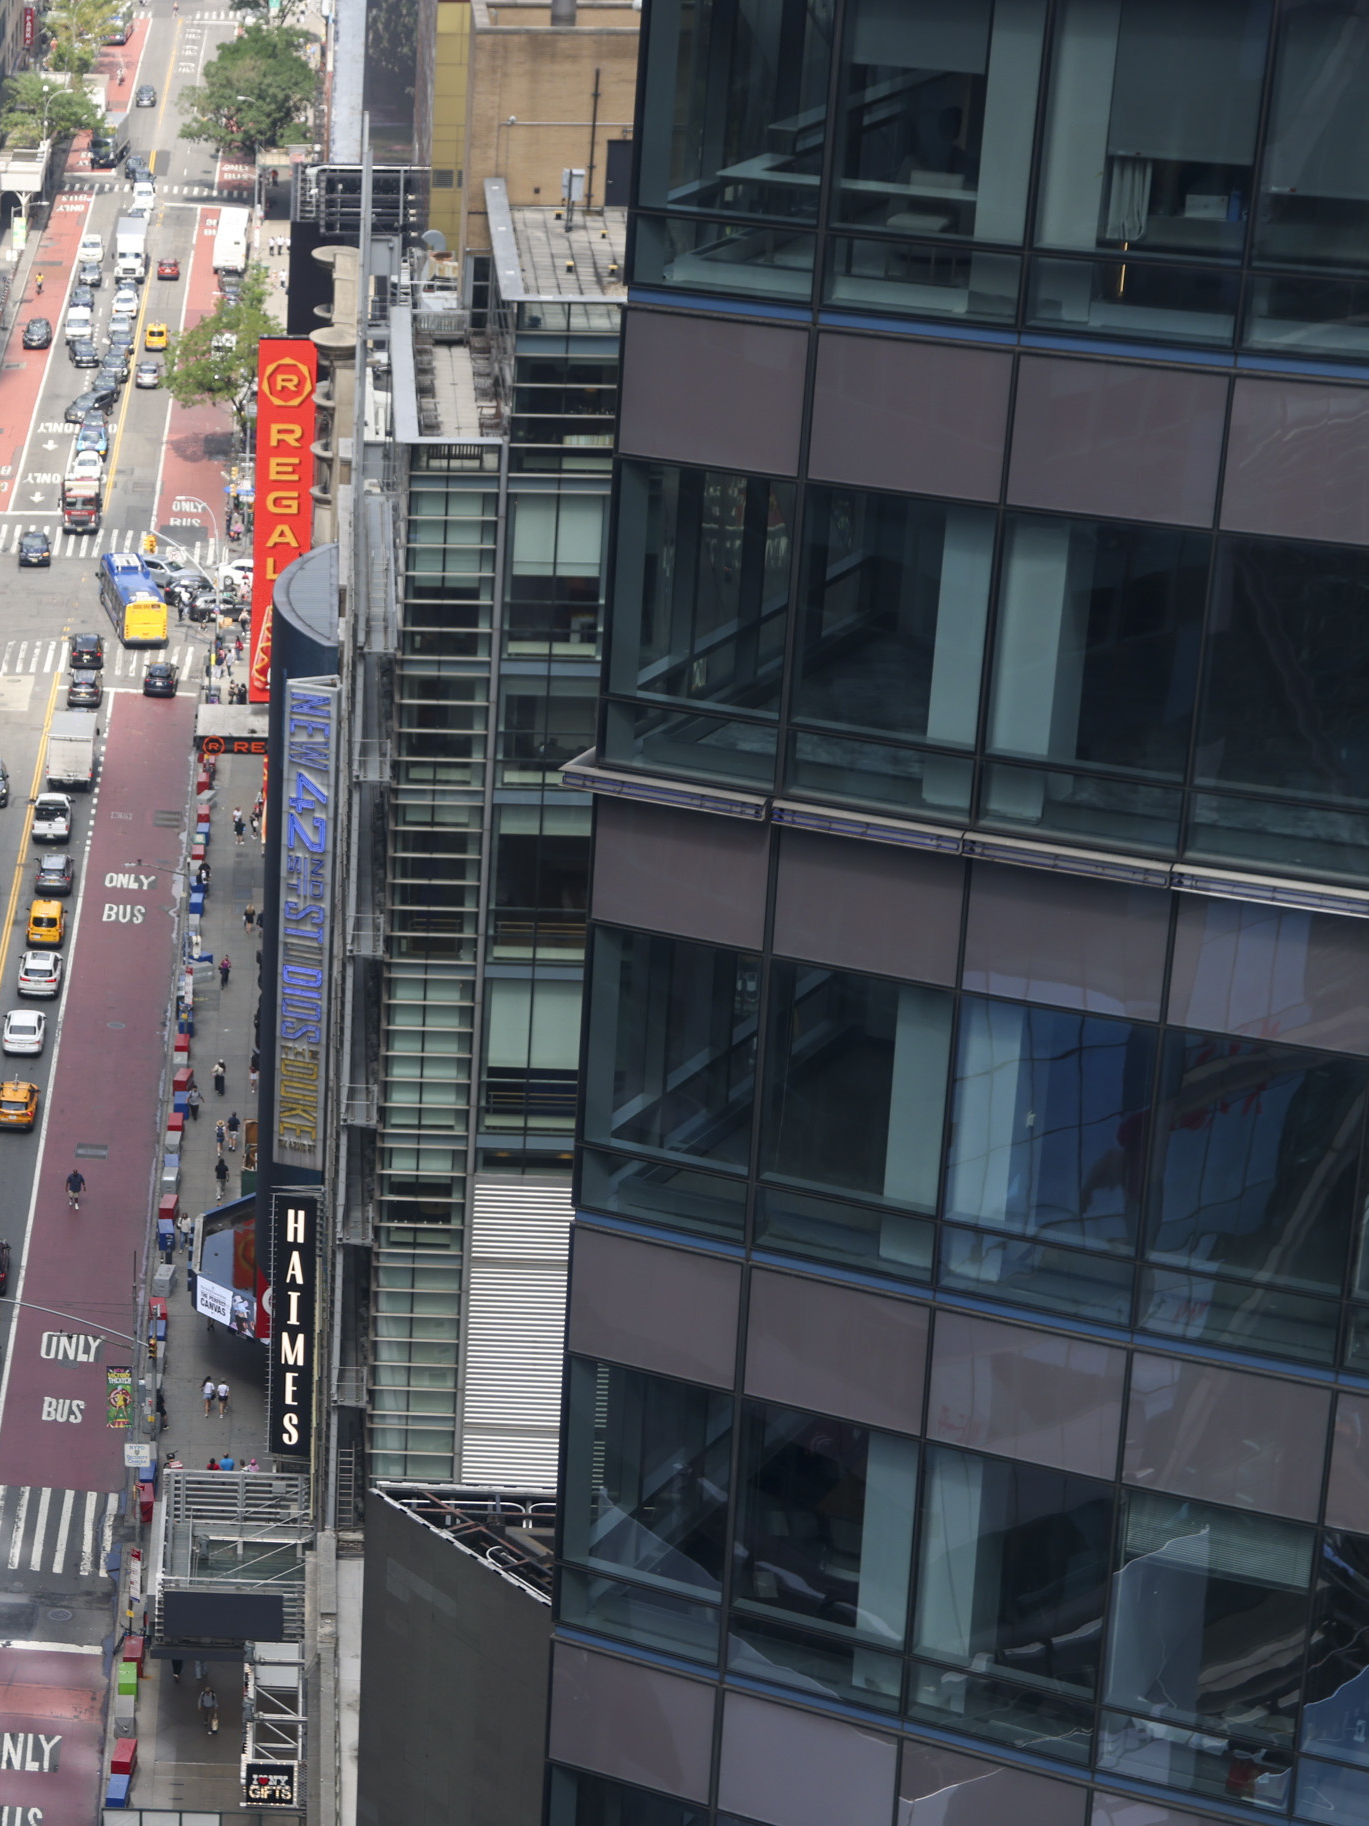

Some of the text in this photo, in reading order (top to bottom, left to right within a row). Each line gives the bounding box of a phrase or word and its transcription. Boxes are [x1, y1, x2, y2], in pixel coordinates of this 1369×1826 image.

[173, 501, 204, 513] ONLY
[266, 423, 303, 580] REGAL
[287, 692, 331, 770] NEW
[234, 741, 266, 753] RE
[287, 771, 328, 854] 42
[104, 871, 157, 890] ONLY
[101, 903, 146, 924] BUS
[280, 900, 325, 1042] STUDIOS
[279, 1057, 318, 1141] DUKE
[200, 1297, 226, 1317] CANVAS
[281, 1208, 306, 1446] HAIMES
[40, 1331, 103, 1363] ONLY
[42, 1397, 85, 1424] BUS
[248, 1784, 292, 1800] GIFTS
[268, 1774, 288, 1785] NY
